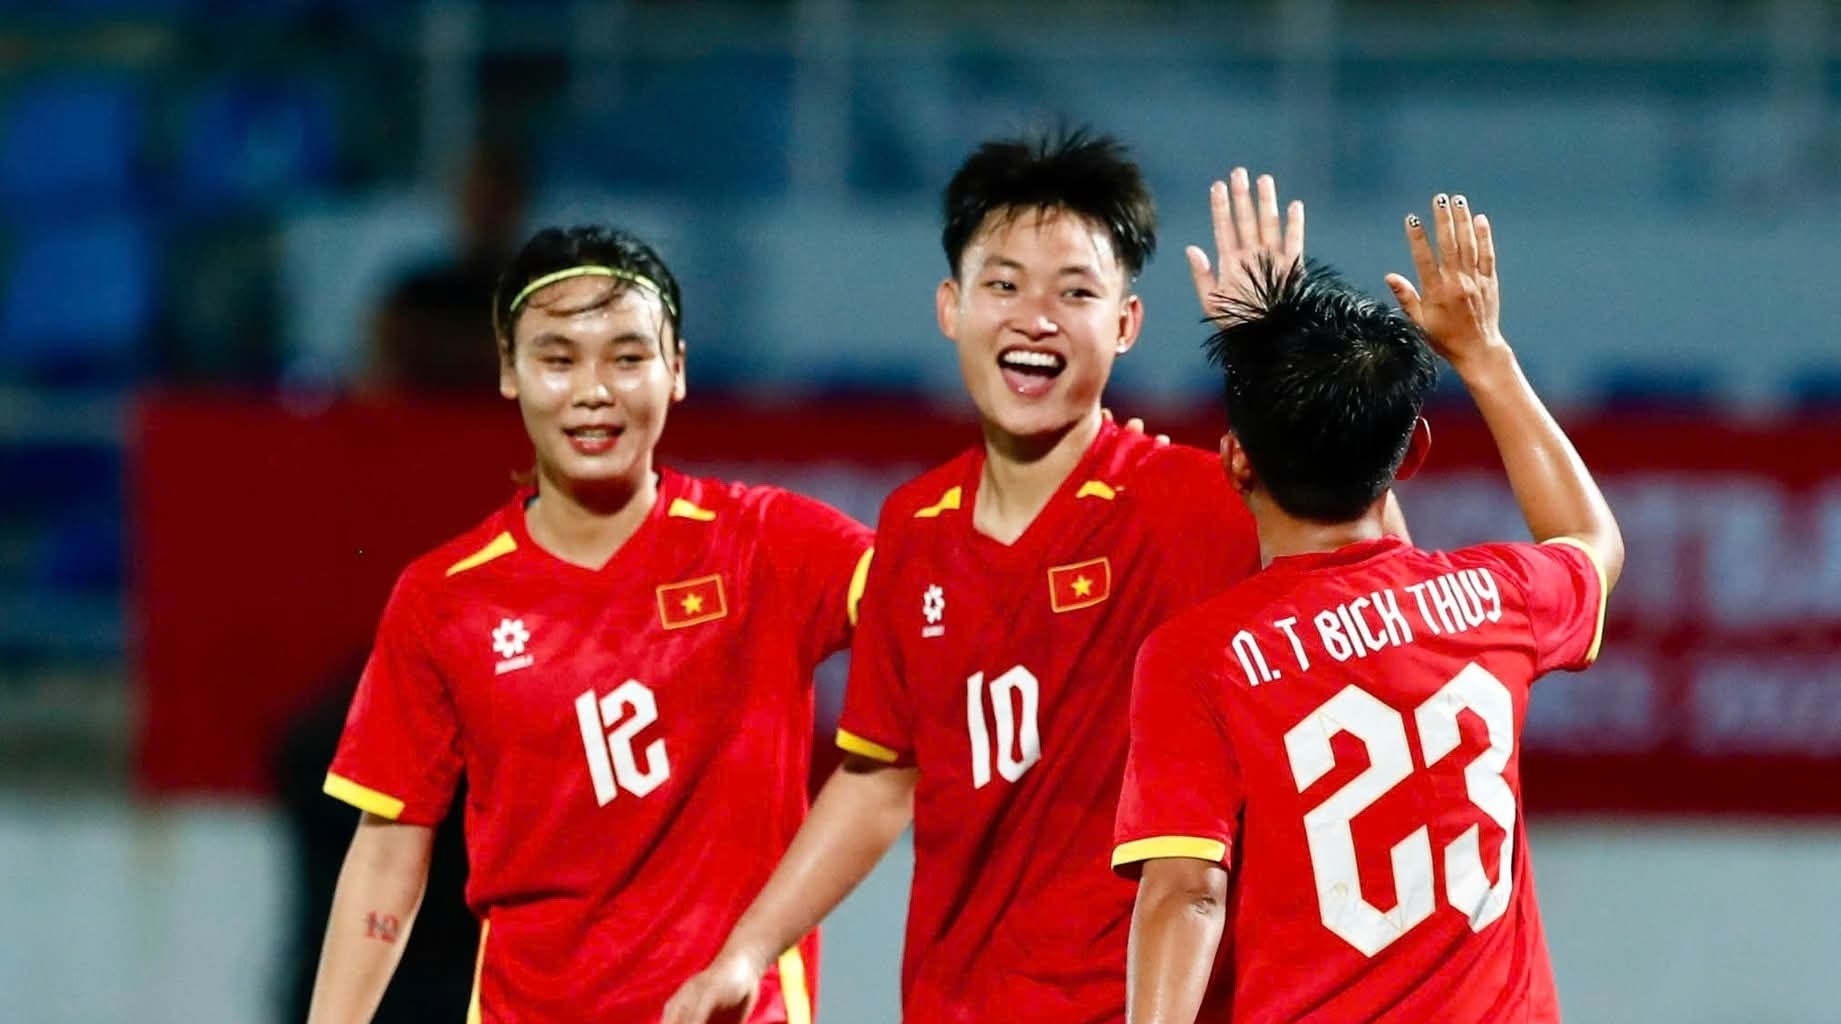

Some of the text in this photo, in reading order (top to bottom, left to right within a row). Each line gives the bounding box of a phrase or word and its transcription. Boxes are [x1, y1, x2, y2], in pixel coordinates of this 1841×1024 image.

[1231, 567, 1503, 687] N. T BICH THUY
[574, 678, 671, 808] 12
[966, 664, 1042, 790] 10
[1283, 661, 1517, 959] 23
